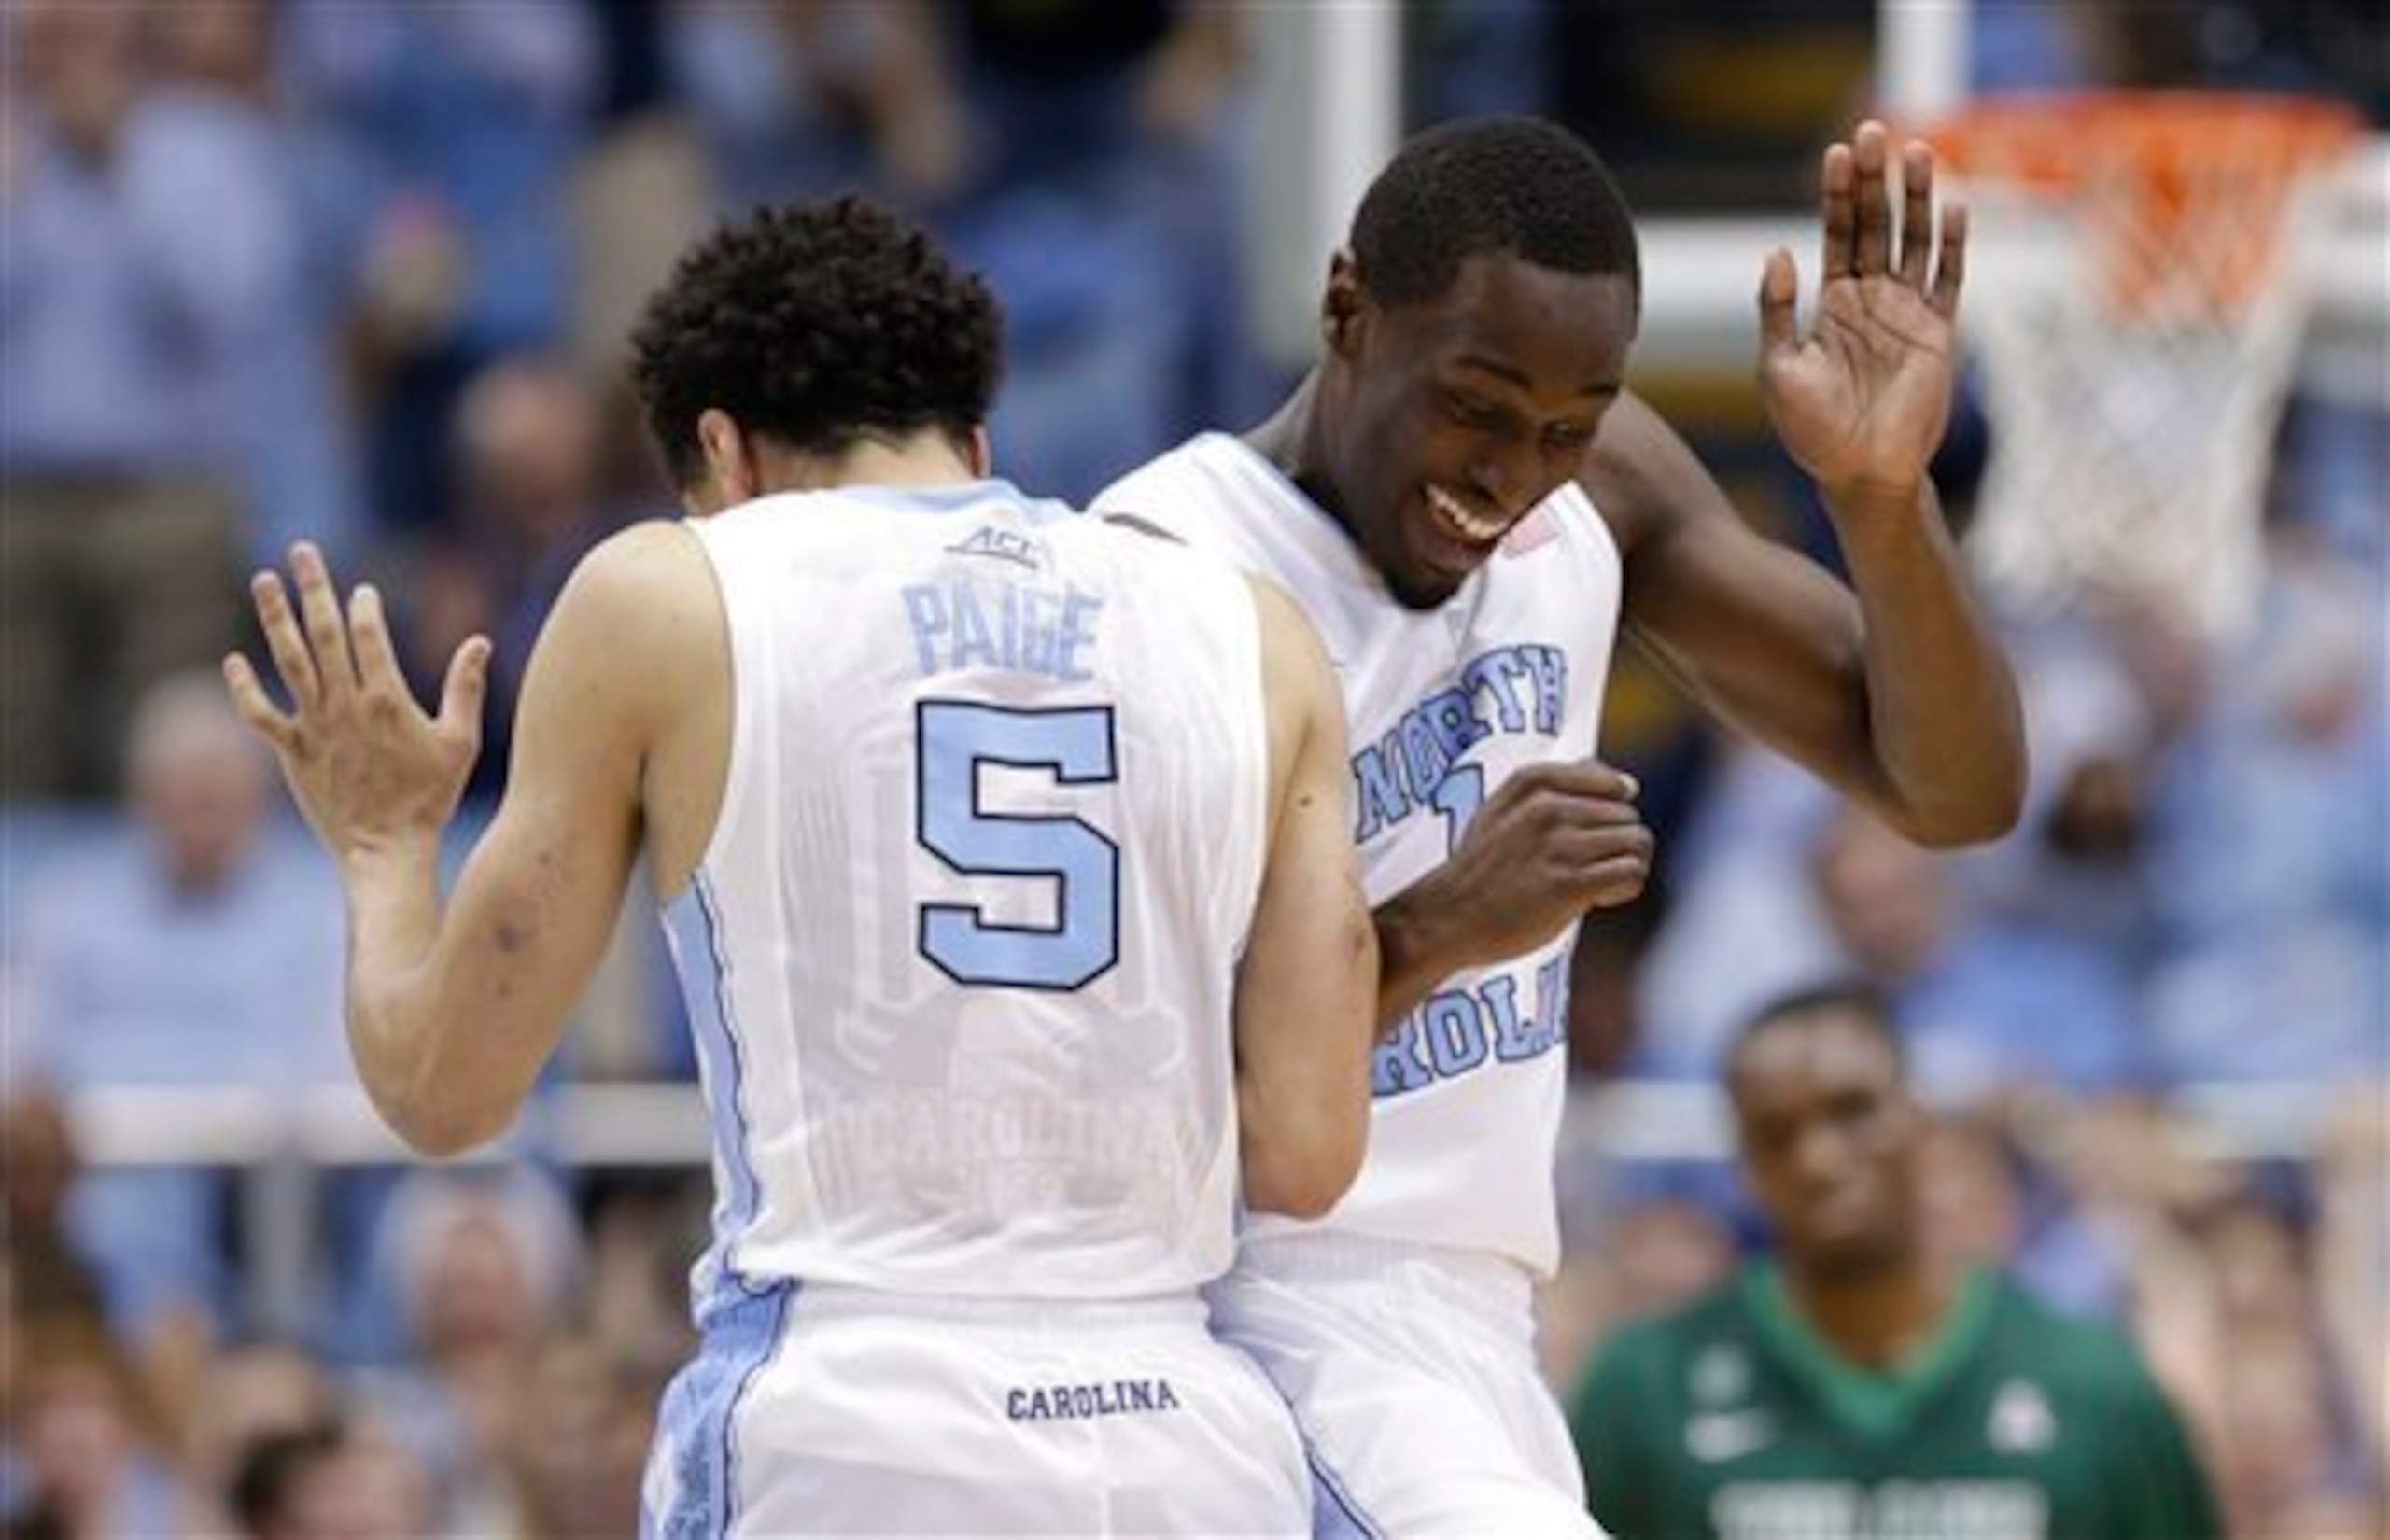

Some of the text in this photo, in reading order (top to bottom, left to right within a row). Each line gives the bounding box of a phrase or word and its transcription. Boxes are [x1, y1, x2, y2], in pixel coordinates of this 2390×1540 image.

[901, 577, 1104, 680] PAIGE
[1351, 644, 1567, 844] NORTH
[916, 698, 1119, 993] 5
[1007, 1379, 1180, 1421] CAROLINA
